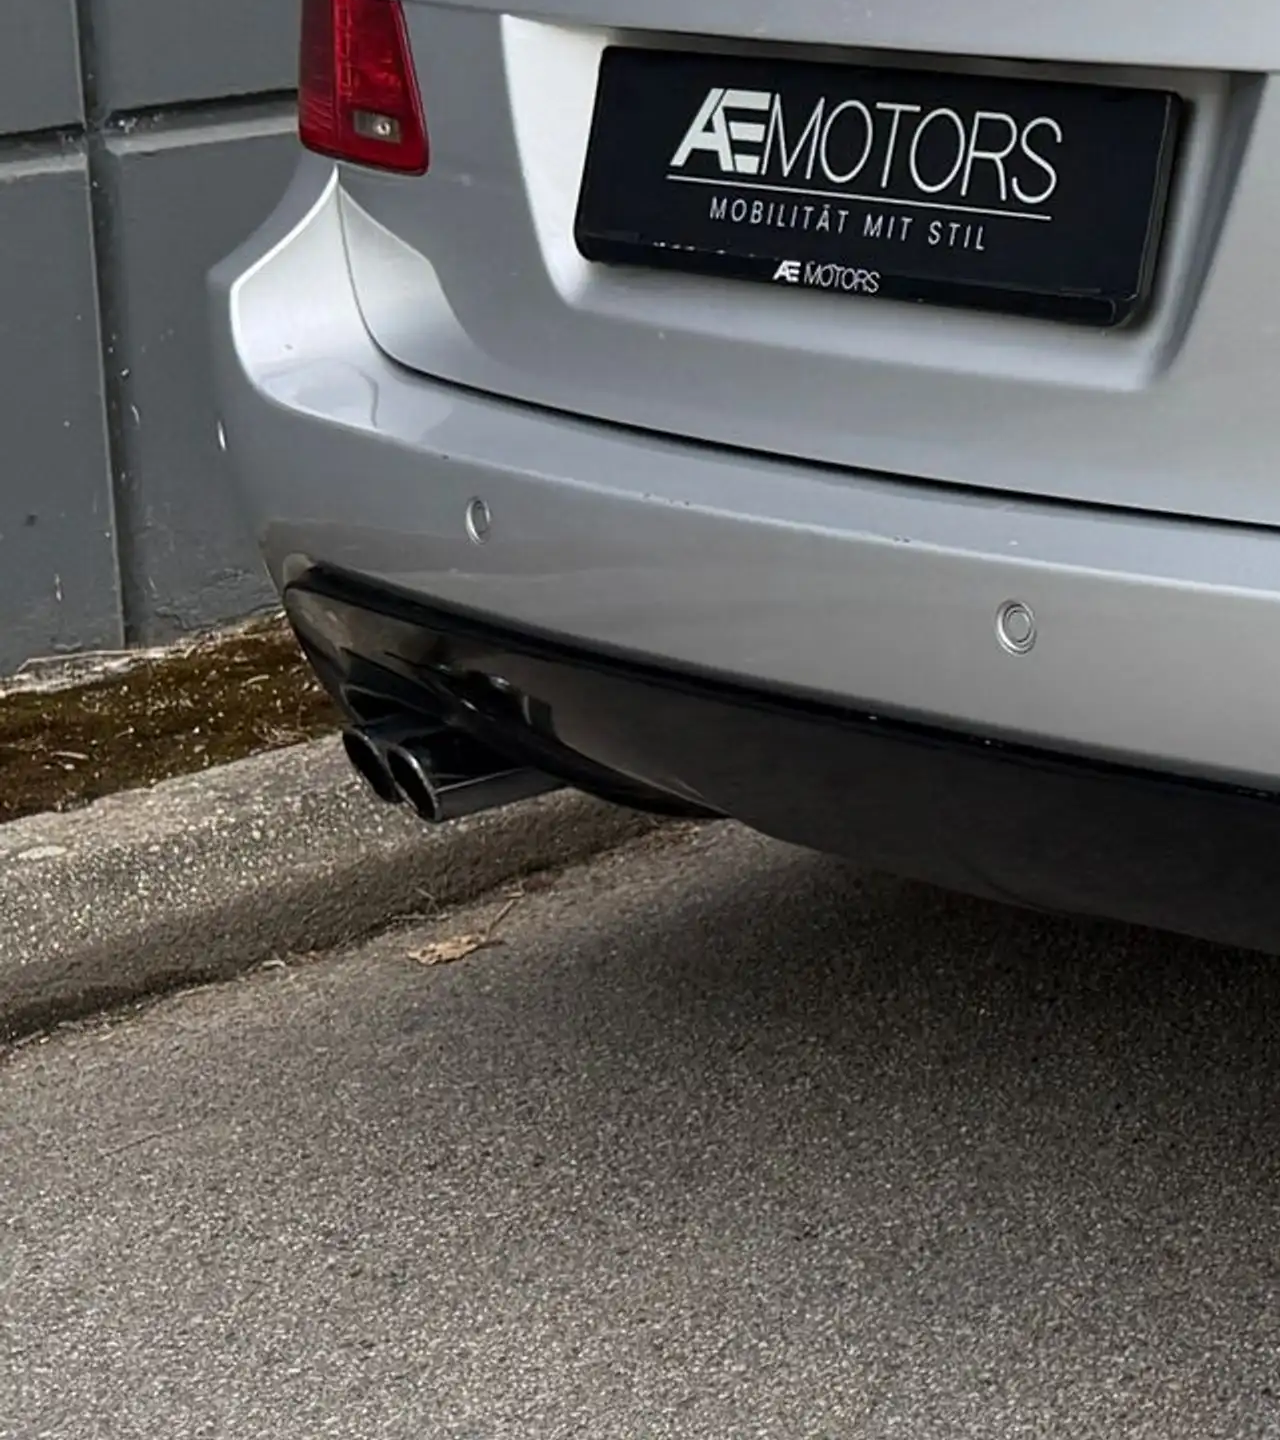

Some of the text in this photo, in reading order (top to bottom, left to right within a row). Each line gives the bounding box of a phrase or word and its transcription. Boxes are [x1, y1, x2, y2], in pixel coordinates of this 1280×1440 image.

[709, 197, 986, 250] MOBILITÄT MIT STIL
[804, 261, 880, 293] MOTORS
